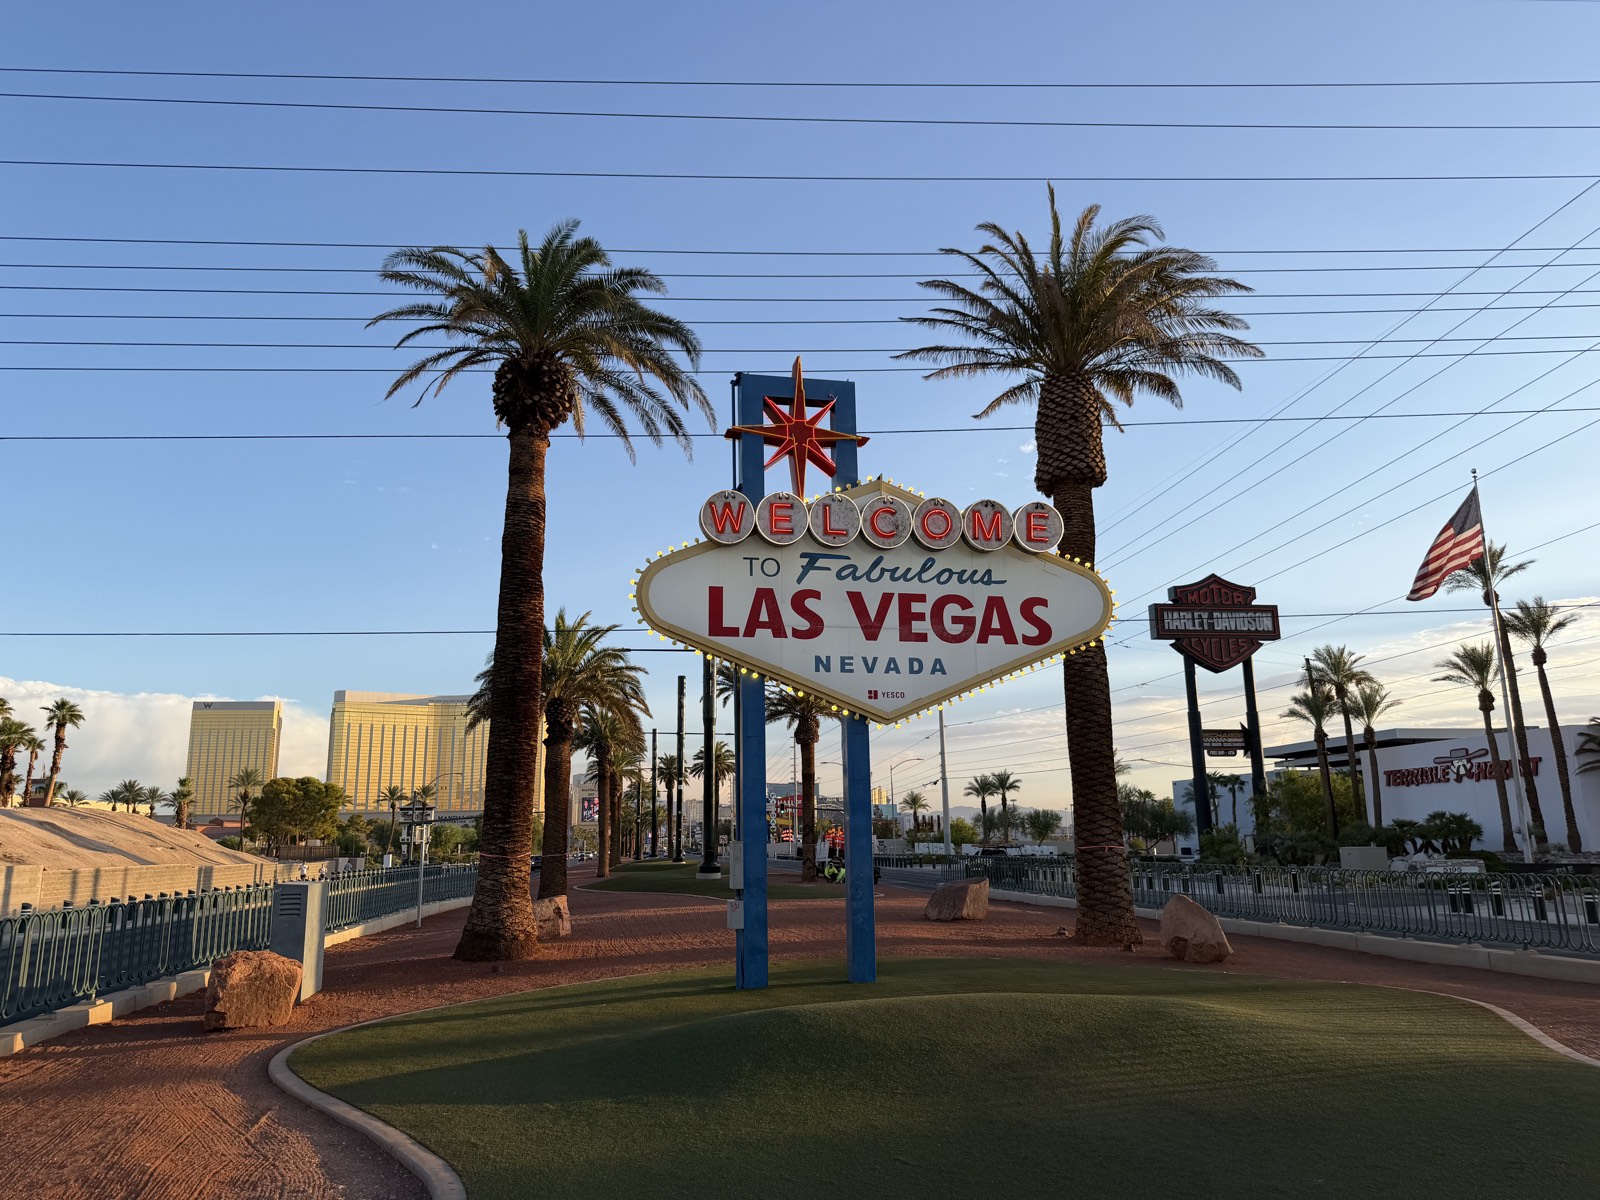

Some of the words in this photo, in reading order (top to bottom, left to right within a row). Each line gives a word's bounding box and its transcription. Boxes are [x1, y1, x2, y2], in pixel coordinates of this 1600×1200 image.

[708, 501, 1050, 544] WELCOME
[743, 557, 781, 577] TO
[796, 552, 1008, 586] Fabulous
[1188, 584, 1245, 605] MOTOR
[708, 586, 825, 640] LAS
[846, 591, 1053, 646] VEGAS
[1164, 610, 1273, 631] HARLEY-DAVIDSON
[1191, 638, 1247, 662] CYCLES
[814, 655, 947, 675] NEVADA
[881, 691, 905, 699] YESCO
[1384, 765, 1450, 787] TERRIBLE
